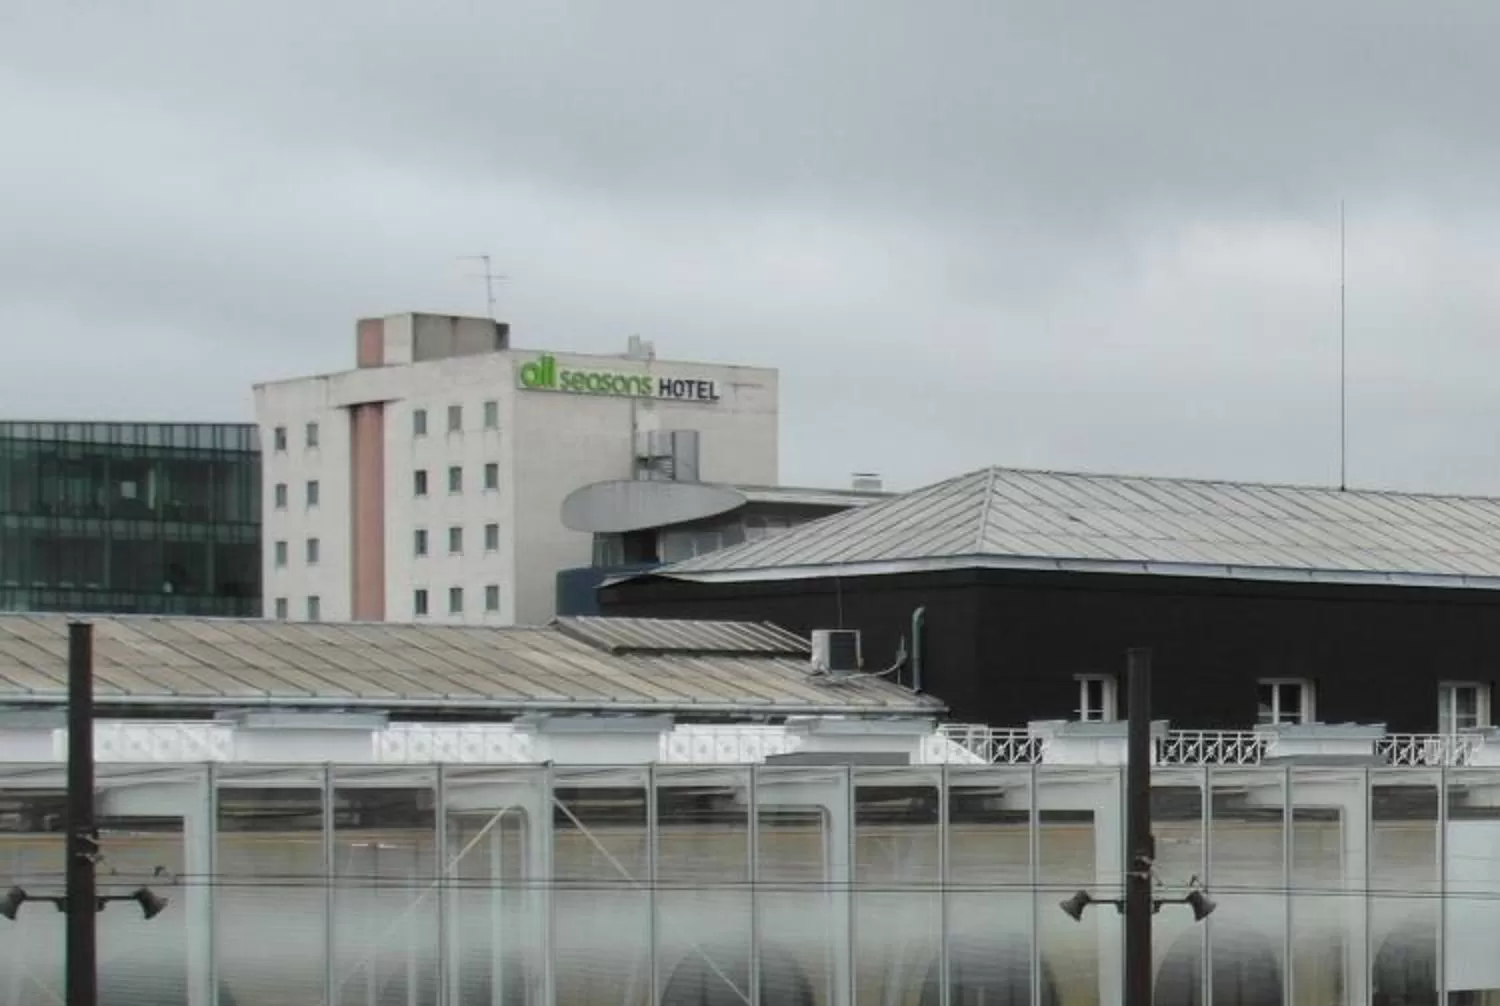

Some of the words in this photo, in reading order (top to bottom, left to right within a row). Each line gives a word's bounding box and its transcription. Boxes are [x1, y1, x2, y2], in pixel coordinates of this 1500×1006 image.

[520, 355, 556, 389] all
[559, 369, 653, 397] seasons
[659, 377, 720, 401] HOTEL
